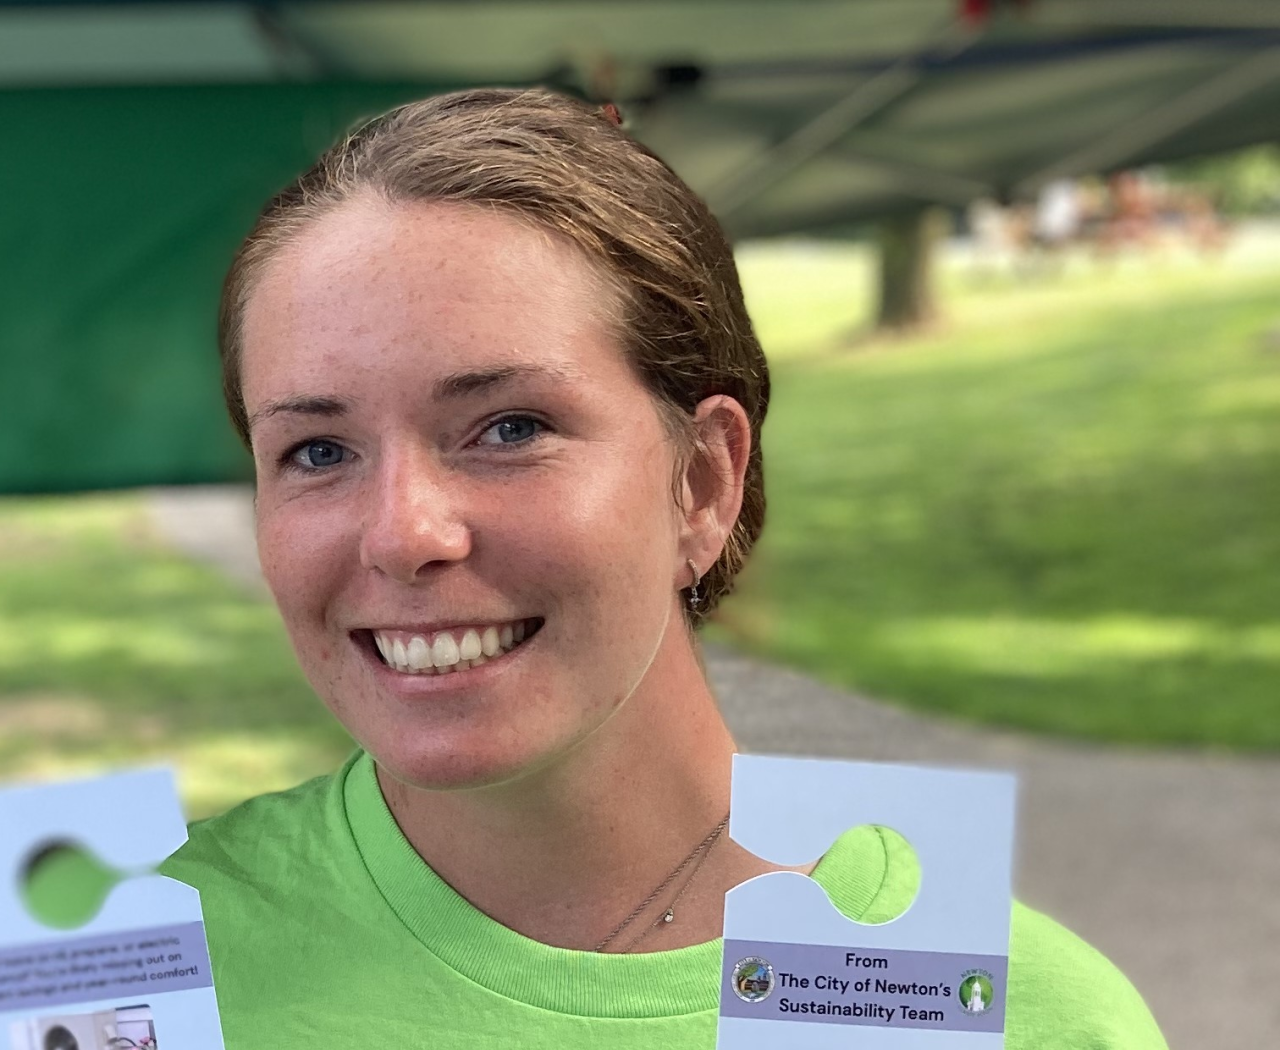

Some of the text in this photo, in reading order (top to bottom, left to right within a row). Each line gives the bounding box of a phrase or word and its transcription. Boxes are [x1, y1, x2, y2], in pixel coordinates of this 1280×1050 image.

[147, 955, 165, 965] out
[167, 953, 182, 962] on
[845, 952, 887, 969] From
[149, 965, 199, 981] comfort!
[778, 972, 809, 989] The
[814, 975, 850, 995] City
[854, 977, 871, 992] of
[779, 997, 896, 1023] Sustainability
[899, 1005, 944, 1021] Team
